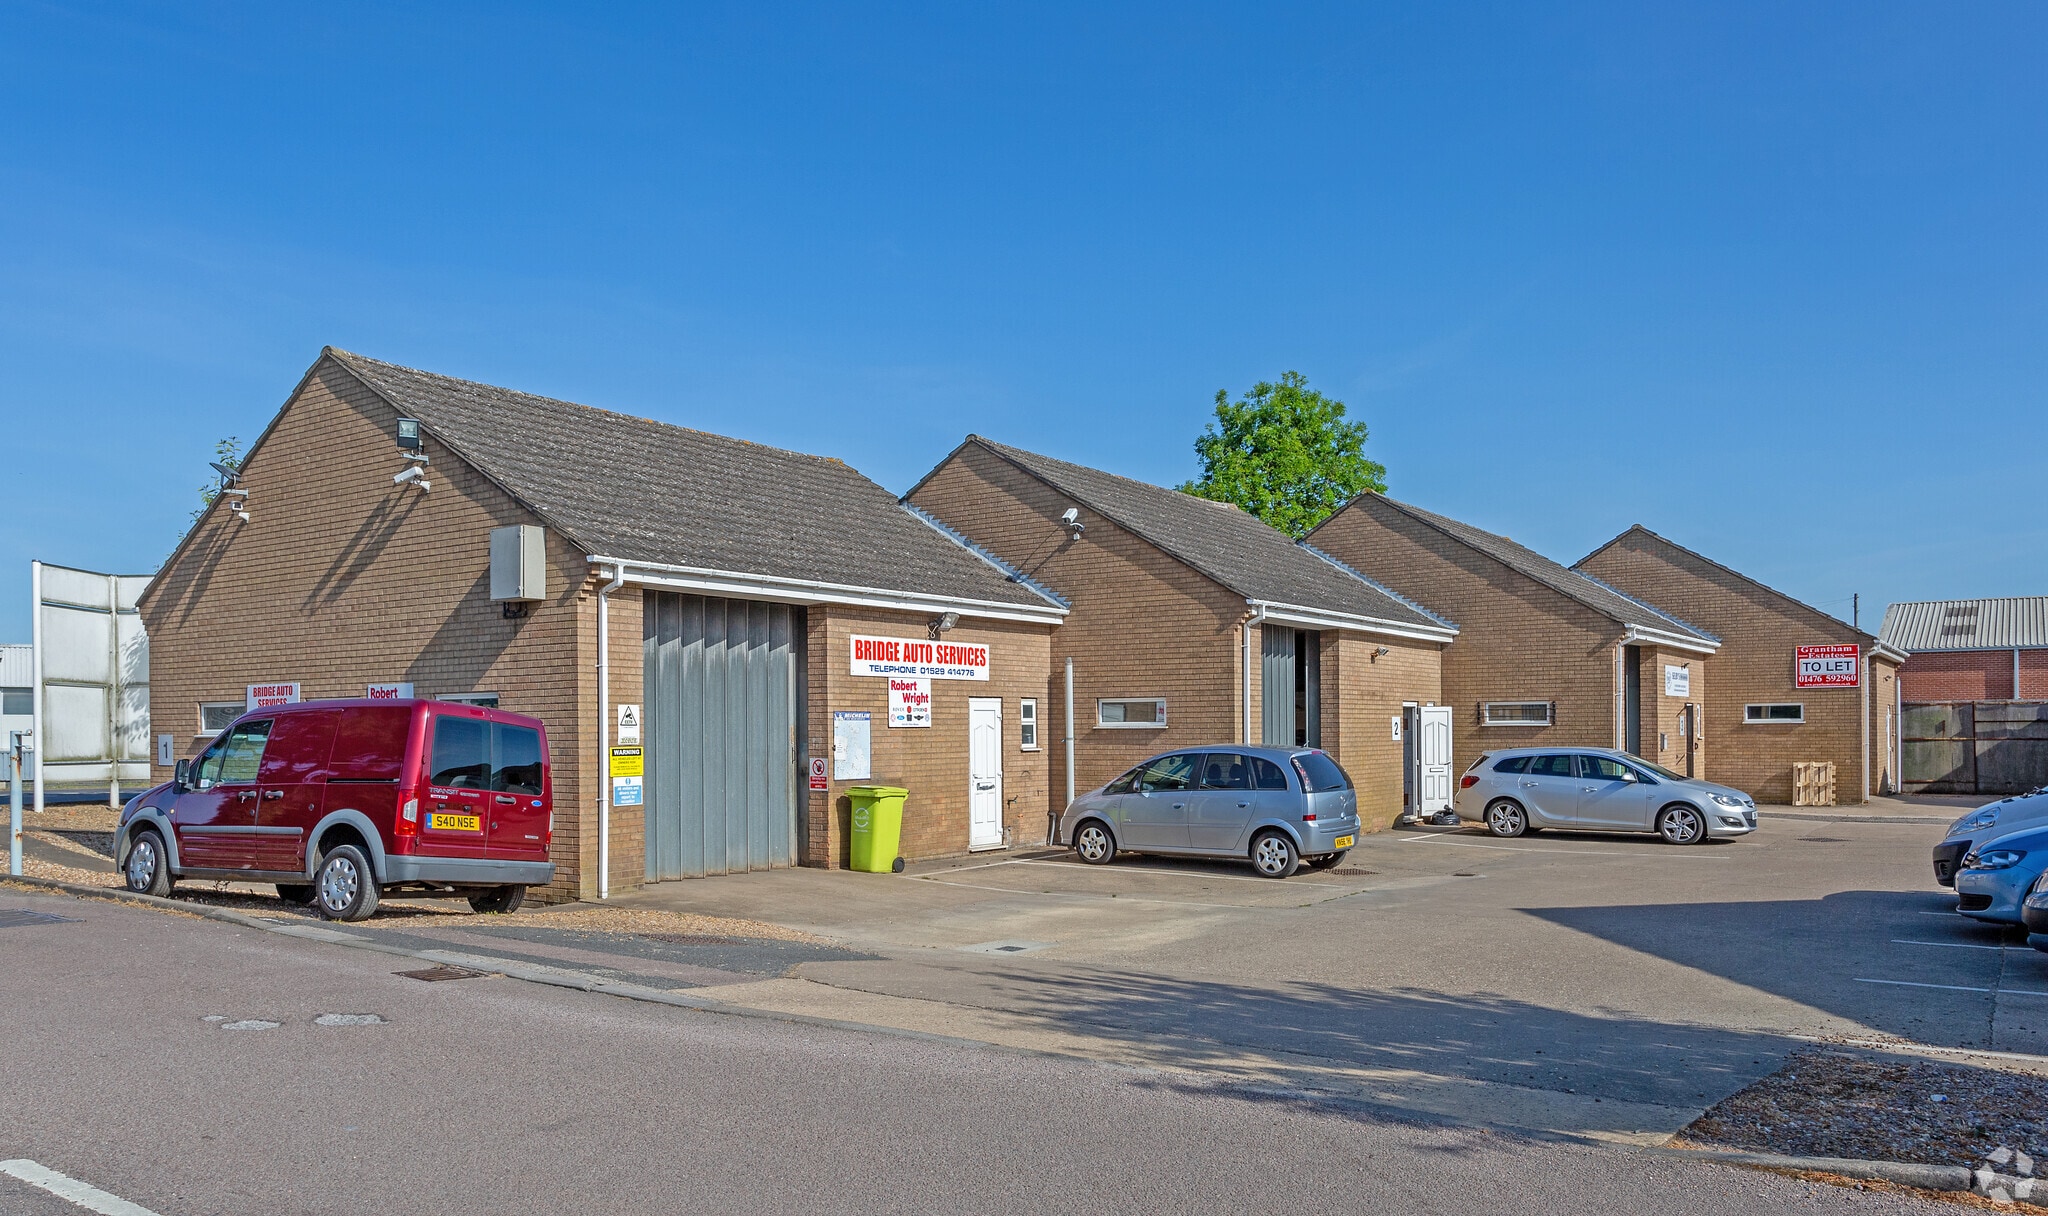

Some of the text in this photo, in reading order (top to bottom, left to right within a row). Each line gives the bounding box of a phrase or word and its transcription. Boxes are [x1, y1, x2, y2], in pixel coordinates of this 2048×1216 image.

[855, 639, 986, 667] BRIDGE AUTO SERVICES
[869, 664, 975, 676] TELEPHONE 01529 414776
[1802, 661, 1853, 672] TO LET
[1799, 674, 1857, 683] 01476 592960
[253, 685, 293, 698] BRIDGE AUTO
[891, 680, 917, 691] Robert
[370, 687, 398, 699] Robert
[902, 692, 929, 706] Wright
[1394, 721, 1399, 735] 2
[163, 741, 168, 759] 1
[429, 787, 459, 795] TRANSIT
[436, 815, 475, 828] S40 NSE
